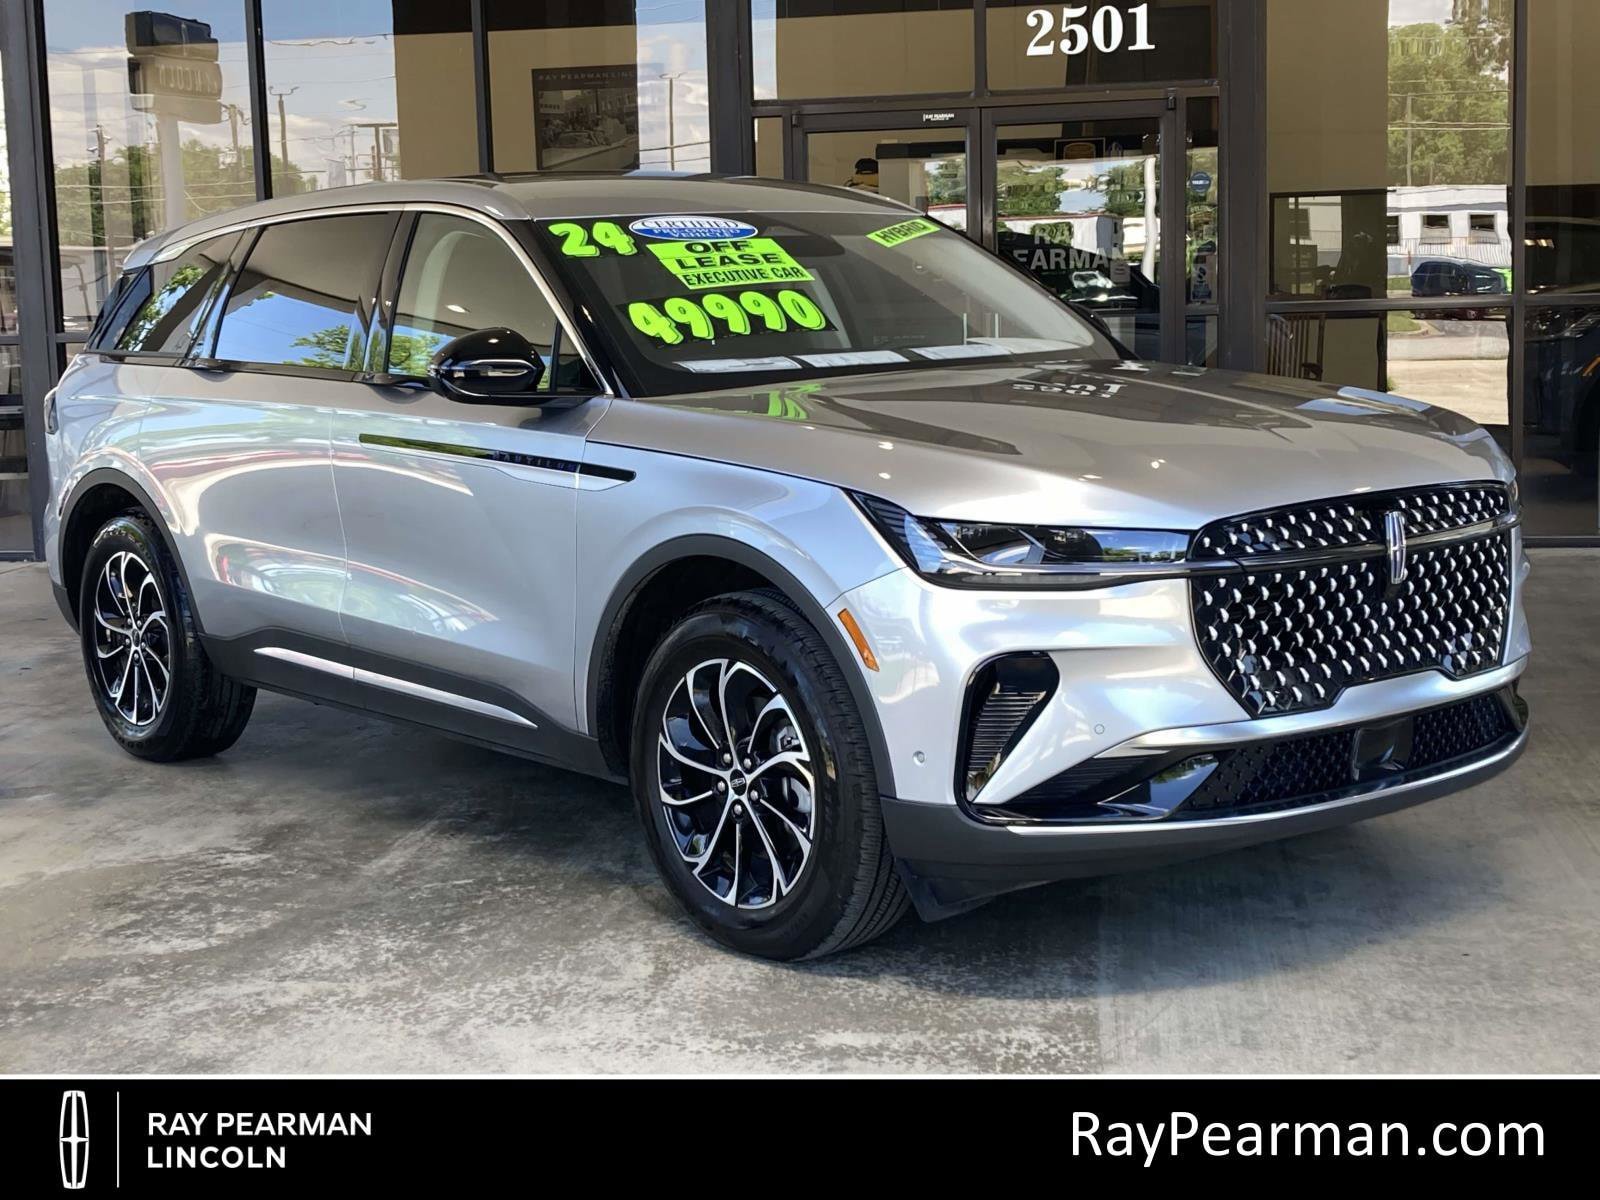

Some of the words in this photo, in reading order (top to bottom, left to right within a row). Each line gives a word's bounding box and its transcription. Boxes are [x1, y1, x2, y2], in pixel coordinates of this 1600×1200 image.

[1026, 3, 1156, 56] 2501
[641, 219, 739, 229] CERTIFIED
[875, 221, 929, 243] HYBRID
[548, 222, 638, 256] 24
[684, 240, 753, 254] OFF
[675, 252, 784, 270] LEASE
[683, 268, 770, 286] EXECUTIVE
[771, 266, 805, 279] CAR
[628, 289, 826, 345] 49990
